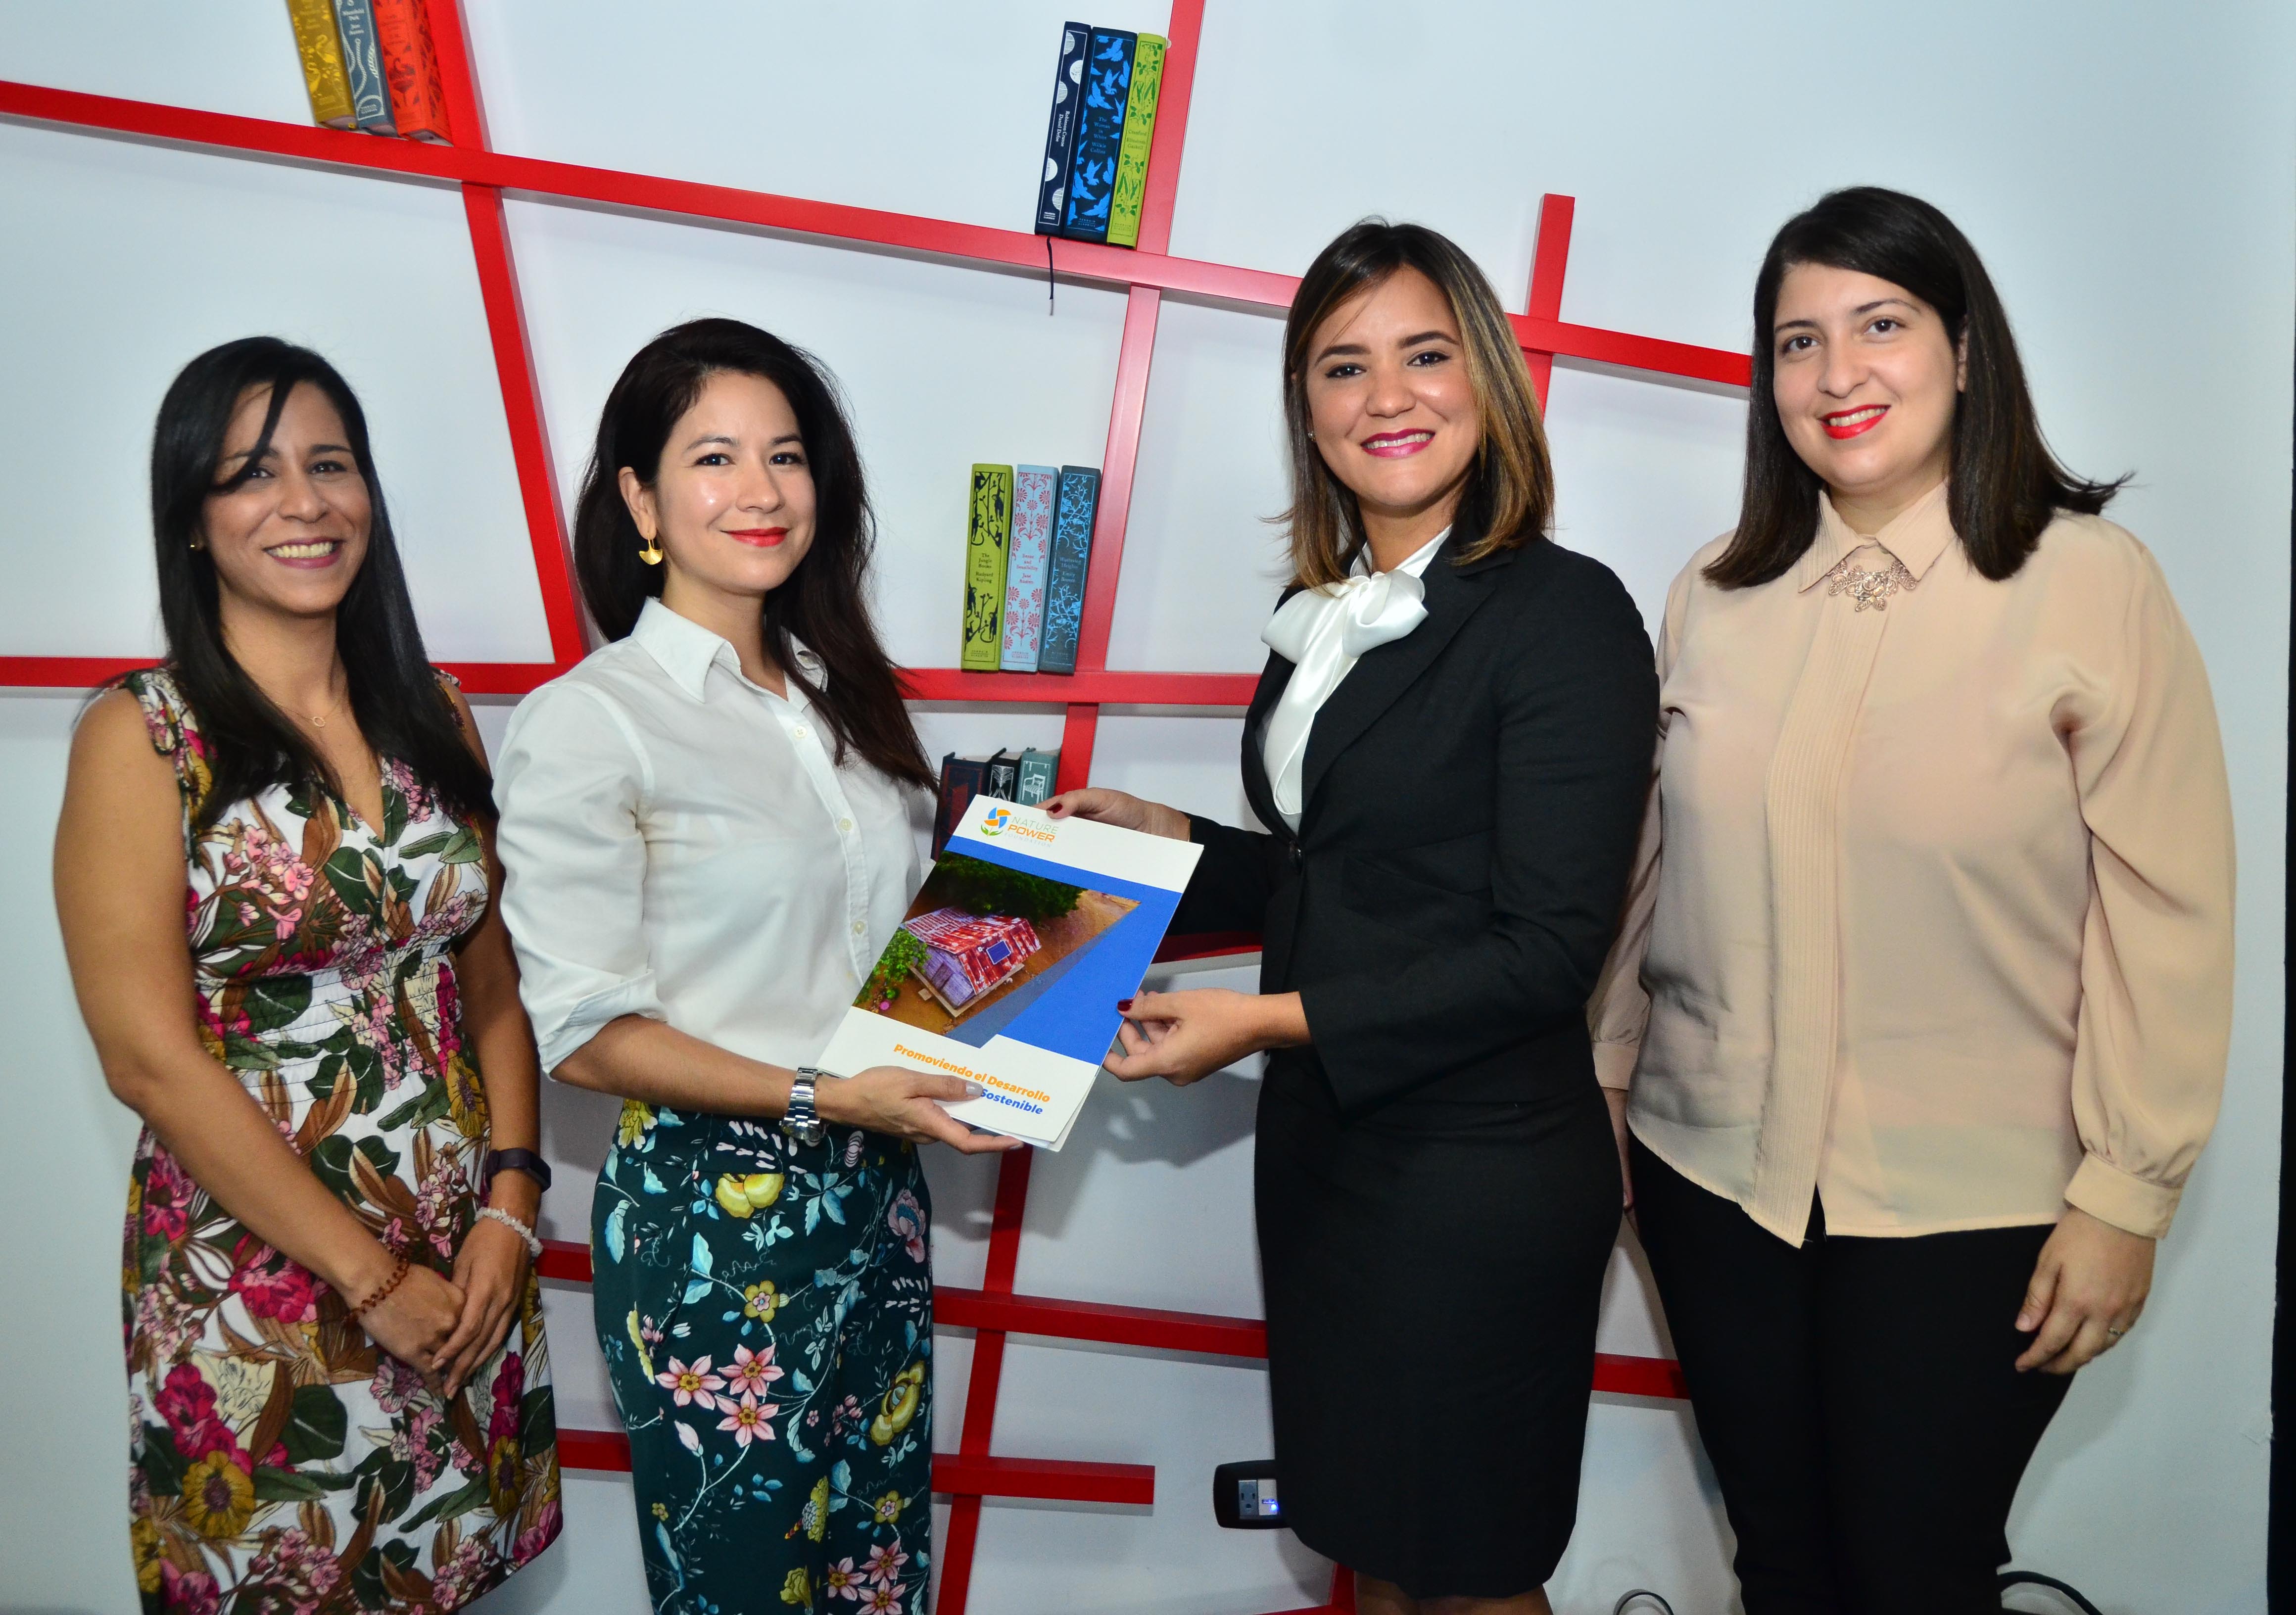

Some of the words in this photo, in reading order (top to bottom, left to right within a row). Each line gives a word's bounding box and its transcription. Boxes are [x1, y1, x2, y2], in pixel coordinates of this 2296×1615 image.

[1007, 824, 1055, 843] POWER
[1011, 816, 1059, 834] NATURE
[1004, 832, 1052, 848] FOUNDATION
[893, 1044, 973, 1078] Promoviendo
[974, 1073, 987, 1083] el
[987, 1076, 1050, 1103] Desarrollo
[980, 1089, 1043, 1115] Sostenible
